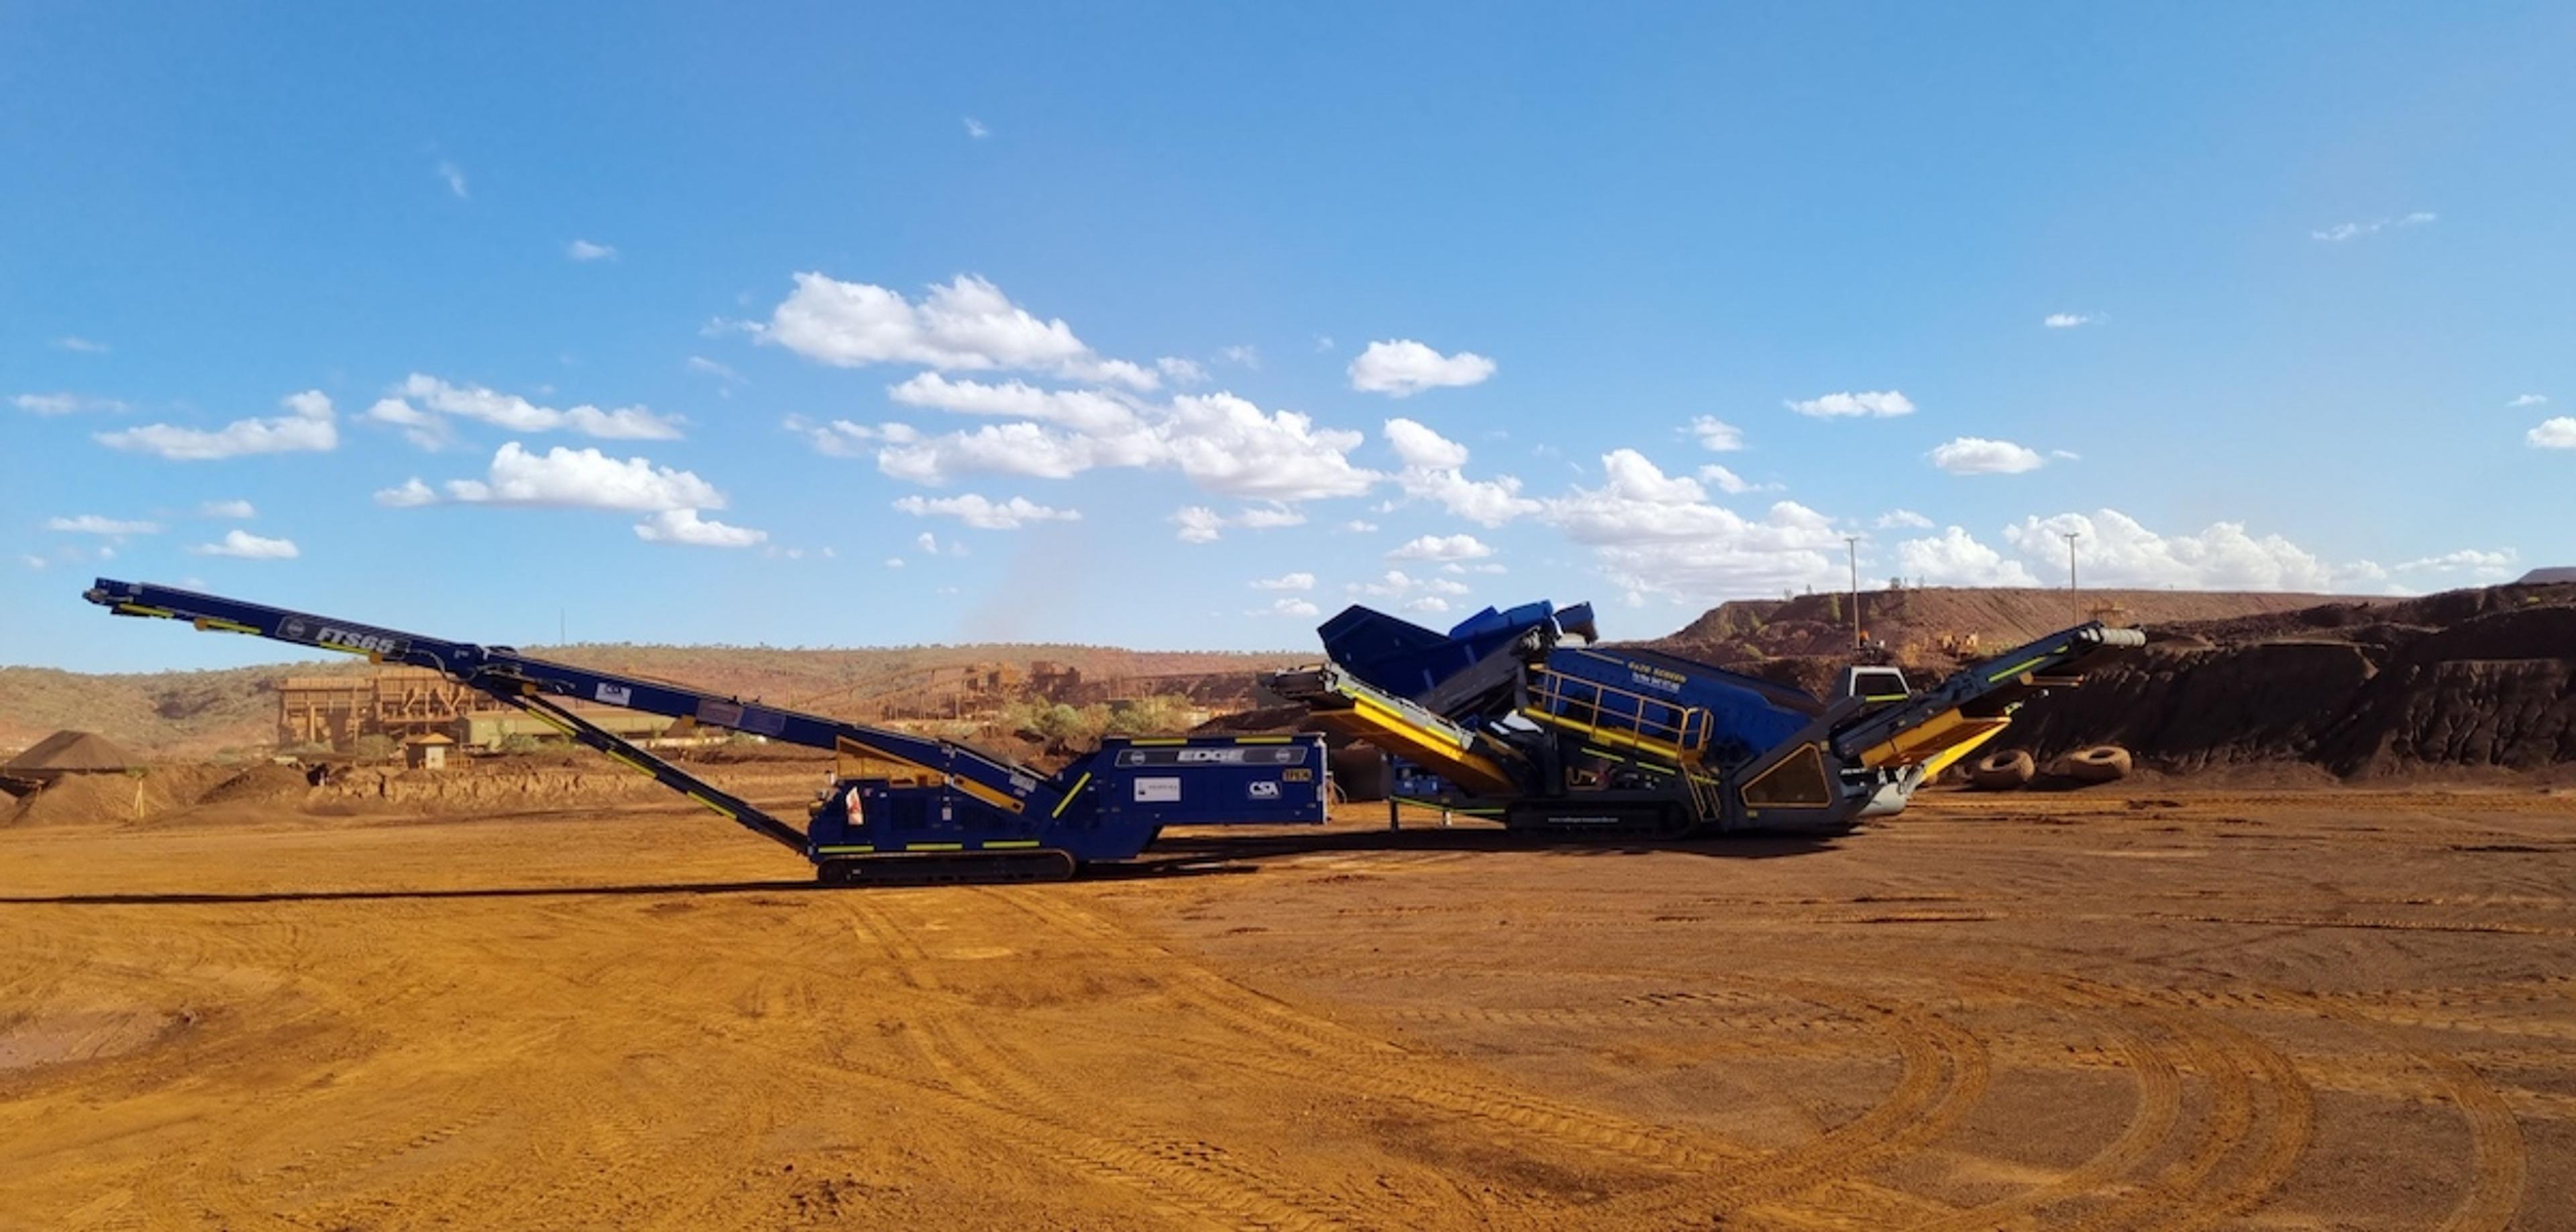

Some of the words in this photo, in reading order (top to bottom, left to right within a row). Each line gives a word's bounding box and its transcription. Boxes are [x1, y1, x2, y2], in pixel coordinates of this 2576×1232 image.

[317, 627, 395, 653] FTS65
[1177, 749, 1245, 762] EDGE
[1249, 781, 1279, 795] CSA
